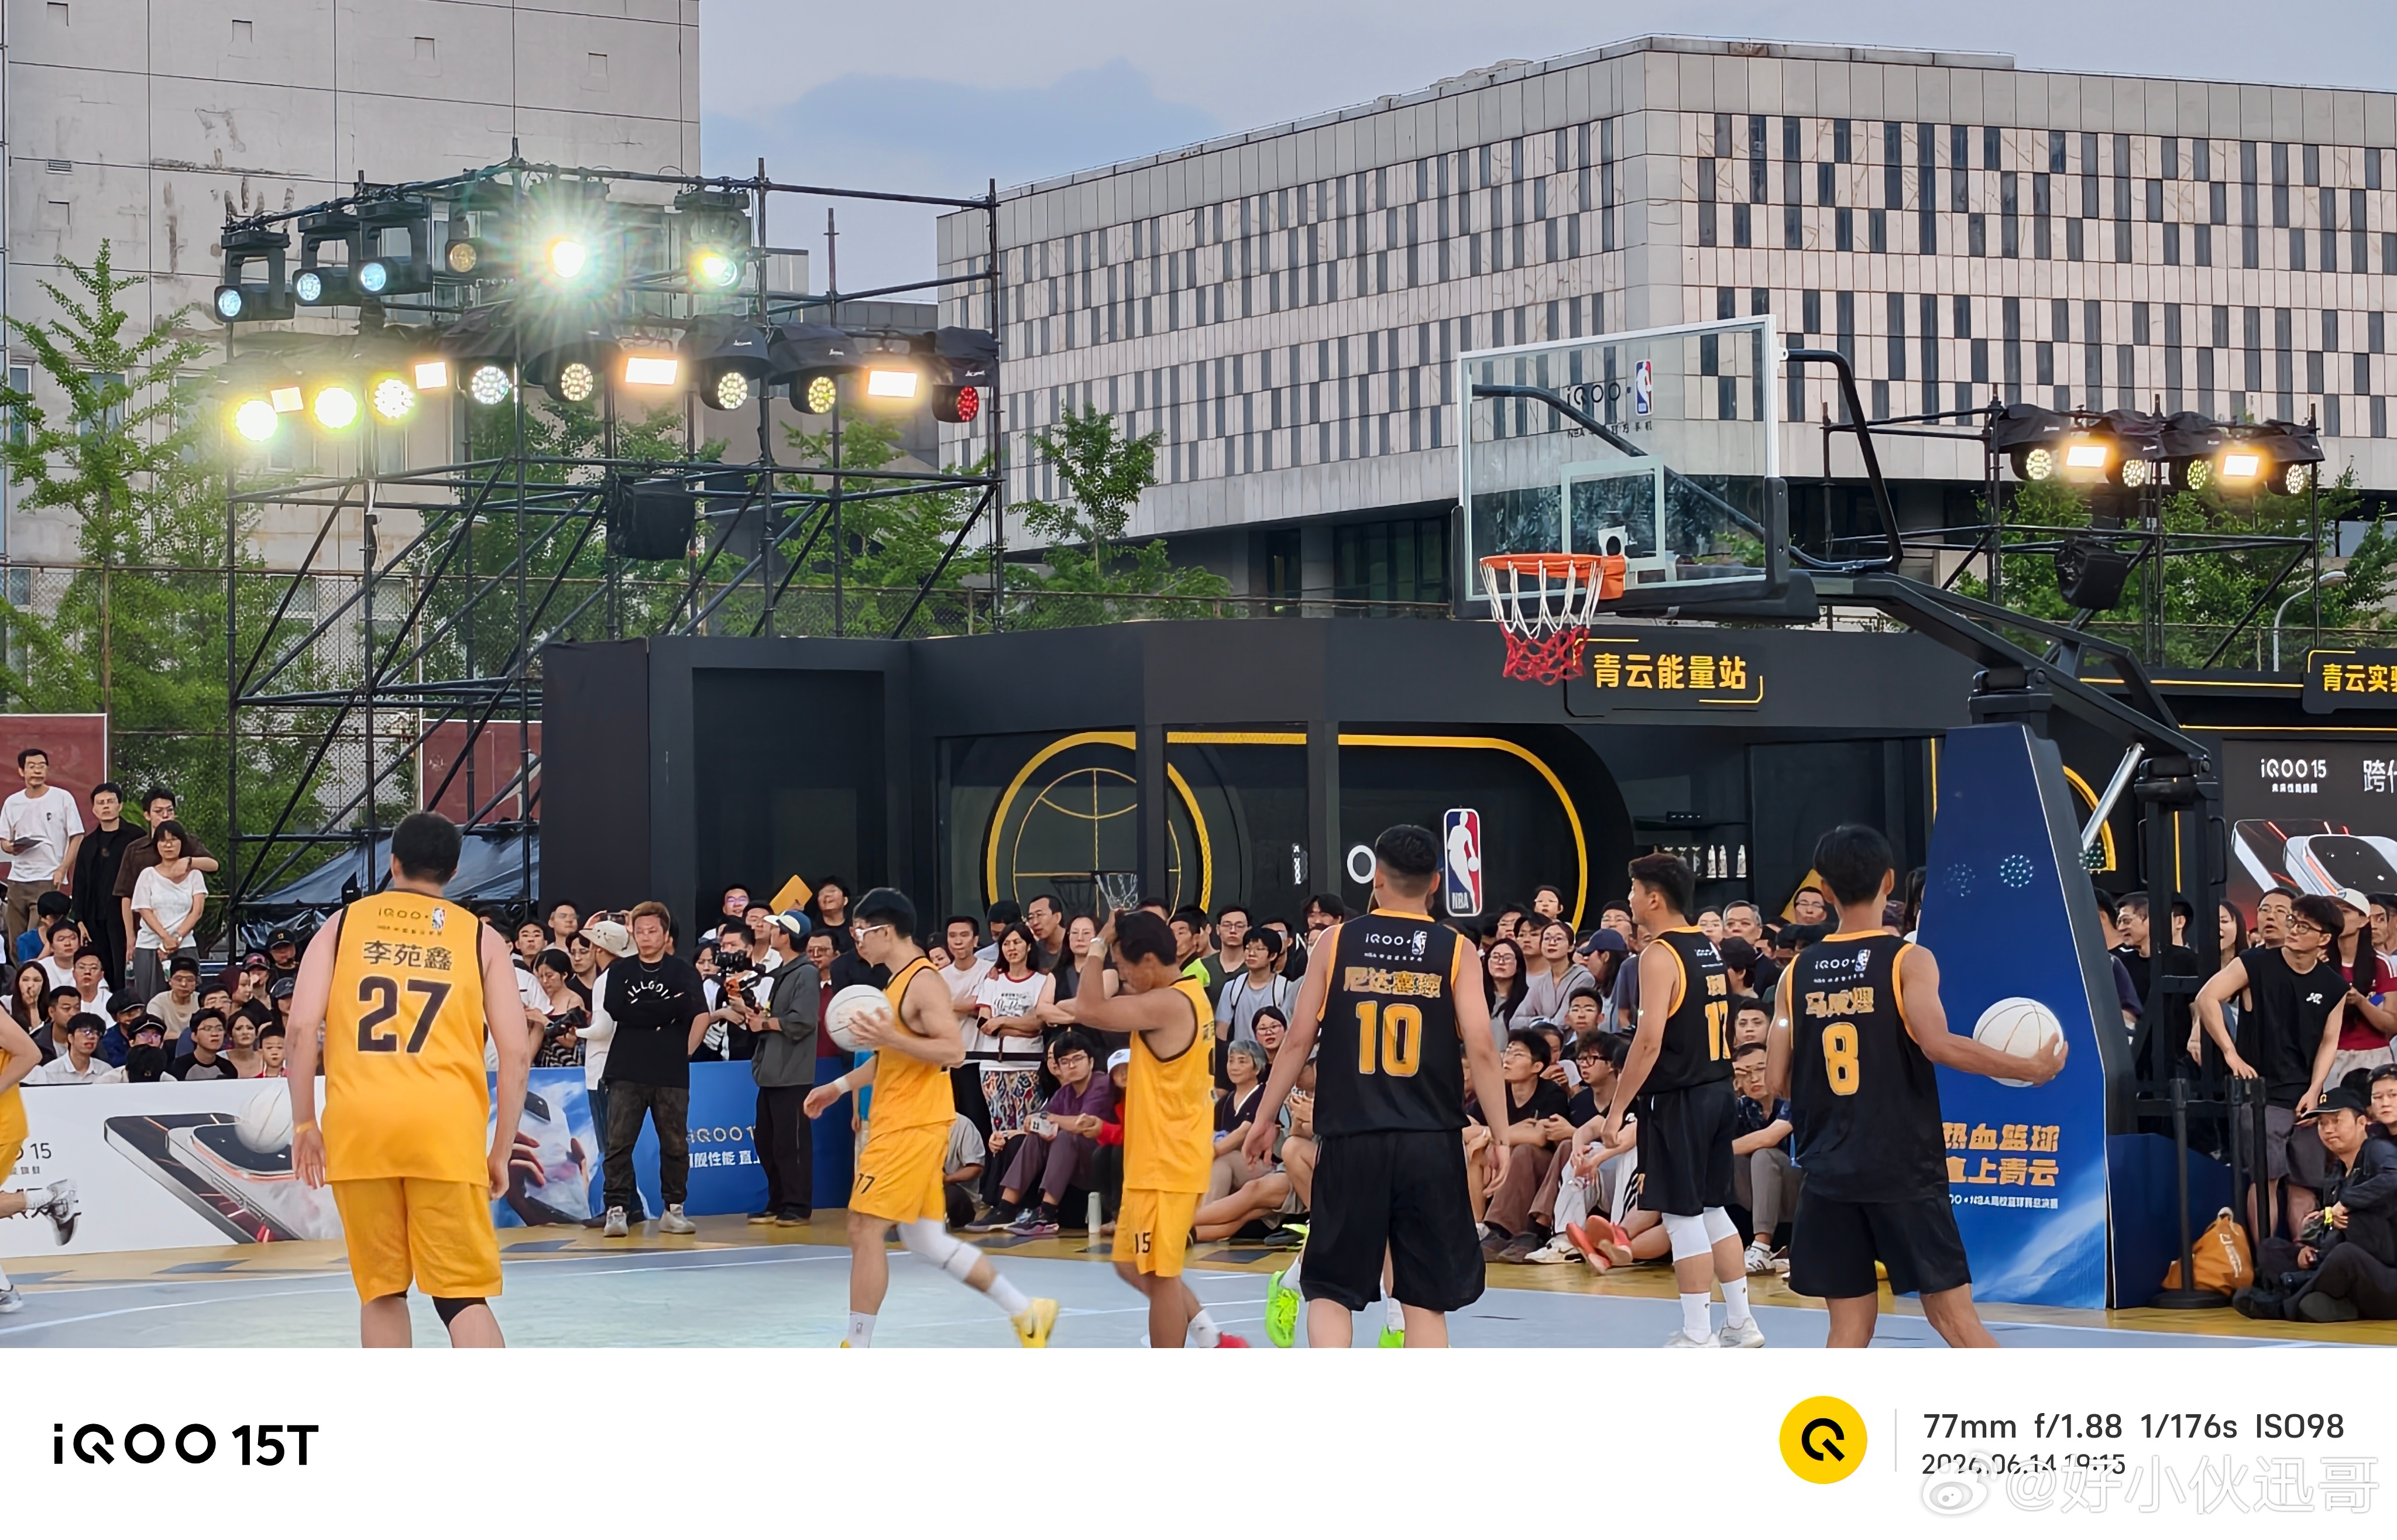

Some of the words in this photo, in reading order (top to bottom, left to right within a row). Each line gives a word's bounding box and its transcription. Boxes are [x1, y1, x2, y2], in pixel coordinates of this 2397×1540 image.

[1594, 653, 1746, 689] 青云能量站
[2322, 663, 2397, 692] 青云实
[2261, 758, 2308, 778] iQOO
[2311, 759, 2327, 778] 15
[1452, 892, 1469, 910] NBA
[363, 940, 452, 971] 李苑鑫
[357, 975, 453, 1054] 27
[1355, 1000, 1423, 1078] 10
[1822, 1022, 1860, 1096] 8
[30, 1143, 52, 1160] 15
[1942, 1122, 2060, 1153] 热血篮球
[1946, 1156, 2059, 1187] 直上青云
[1135, 1232, 1151, 1254] 15
